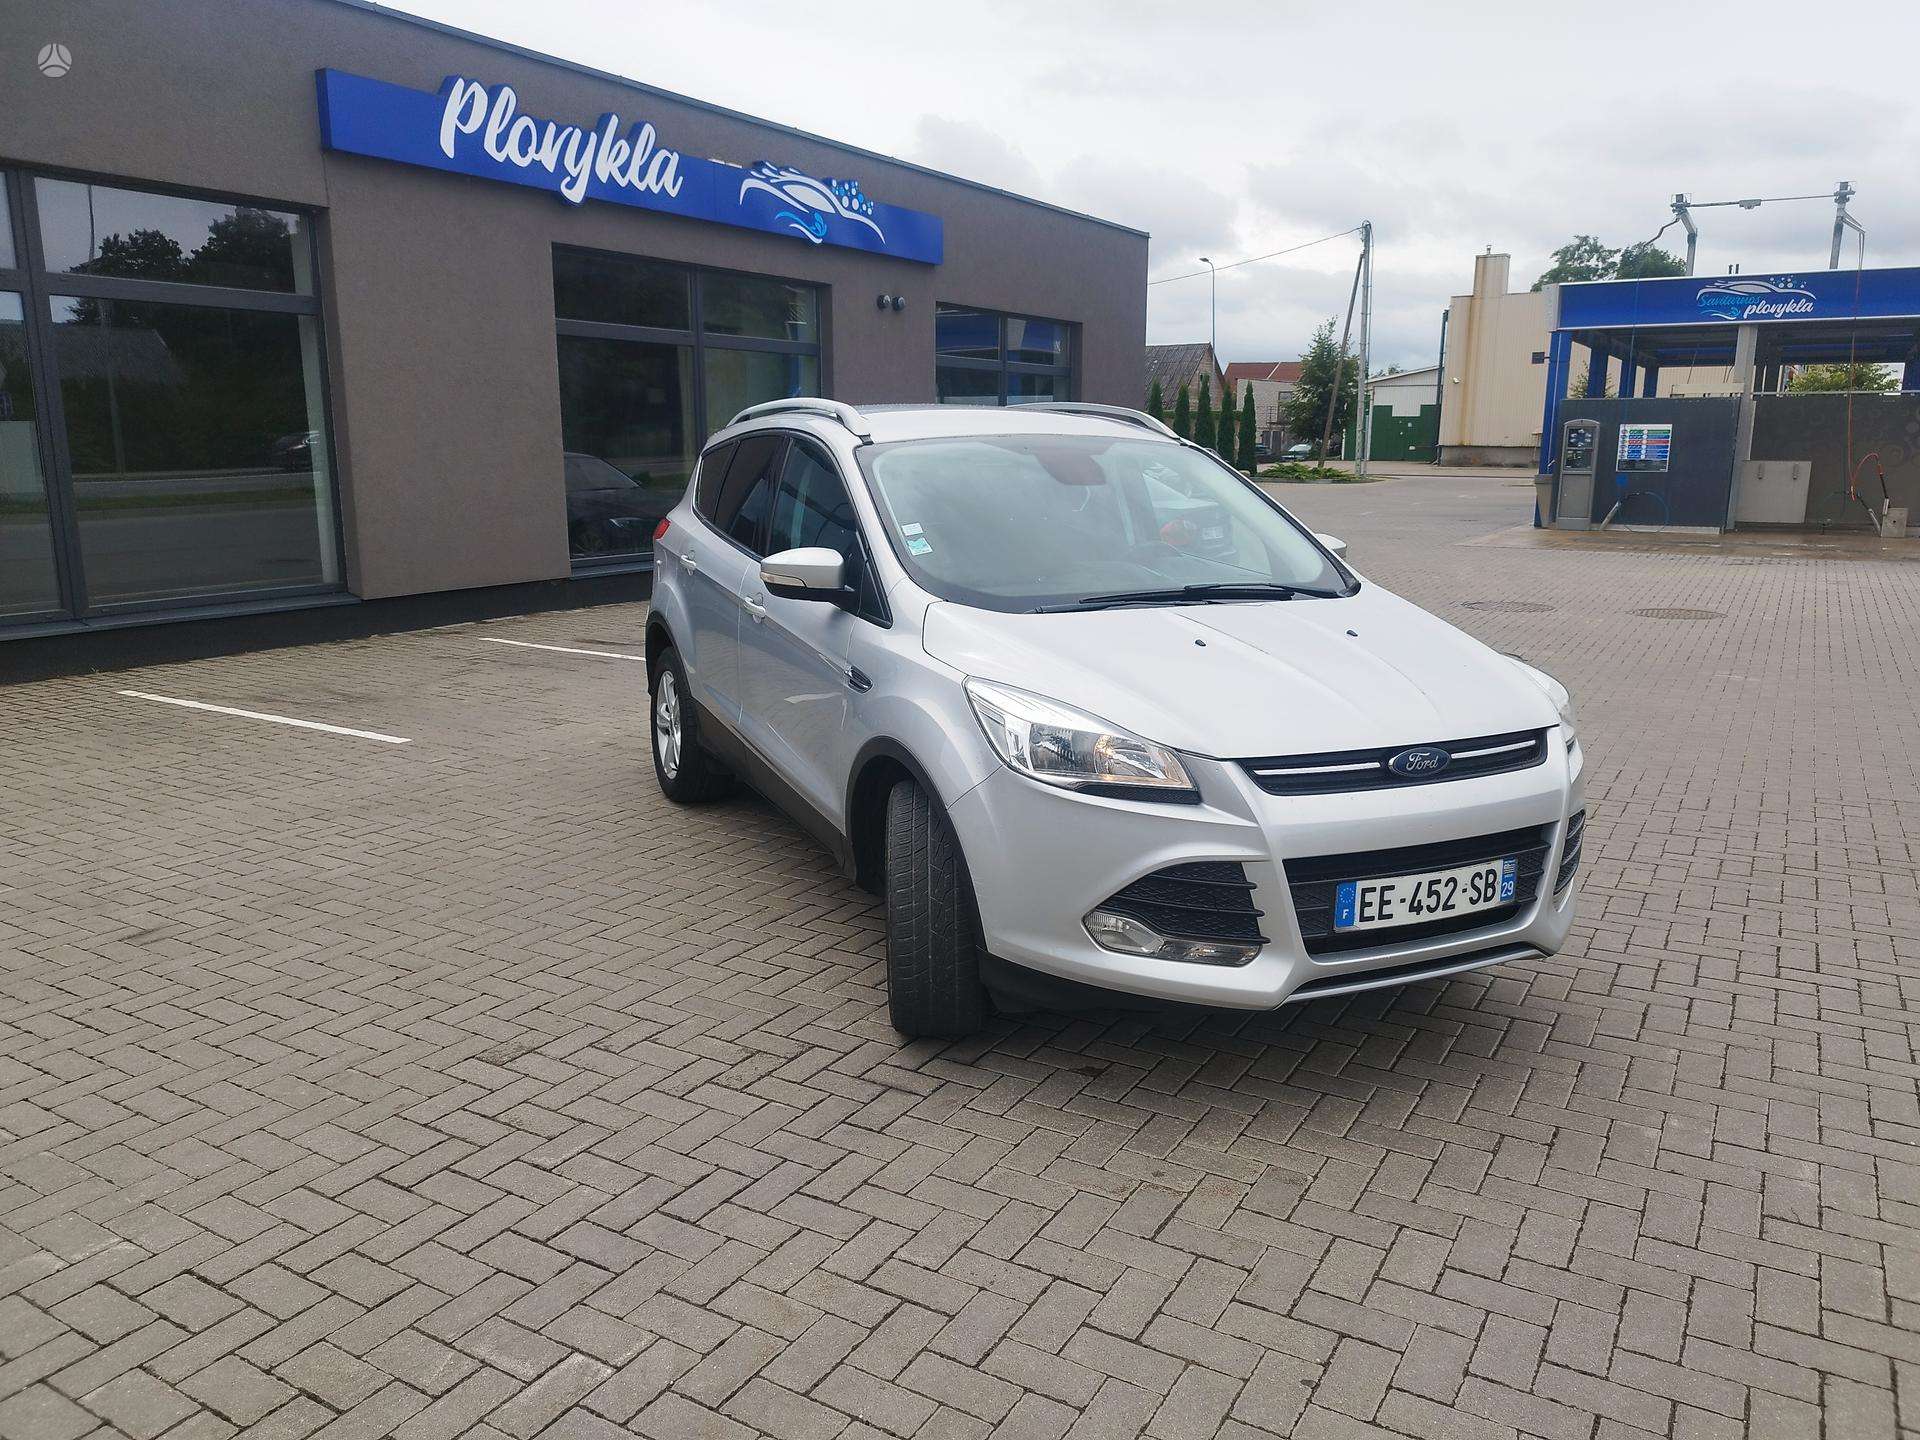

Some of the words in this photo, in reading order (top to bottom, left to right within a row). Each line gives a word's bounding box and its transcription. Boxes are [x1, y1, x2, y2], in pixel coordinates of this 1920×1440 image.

[439, 76, 685, 204] Plovykla
[1406, 752, 1439, 771] Ford
[1341, 909, 1349, 920] F
[1358, 868, 1498, 922] EE-452-SB
[1501, 880, 1514, 897] 29
